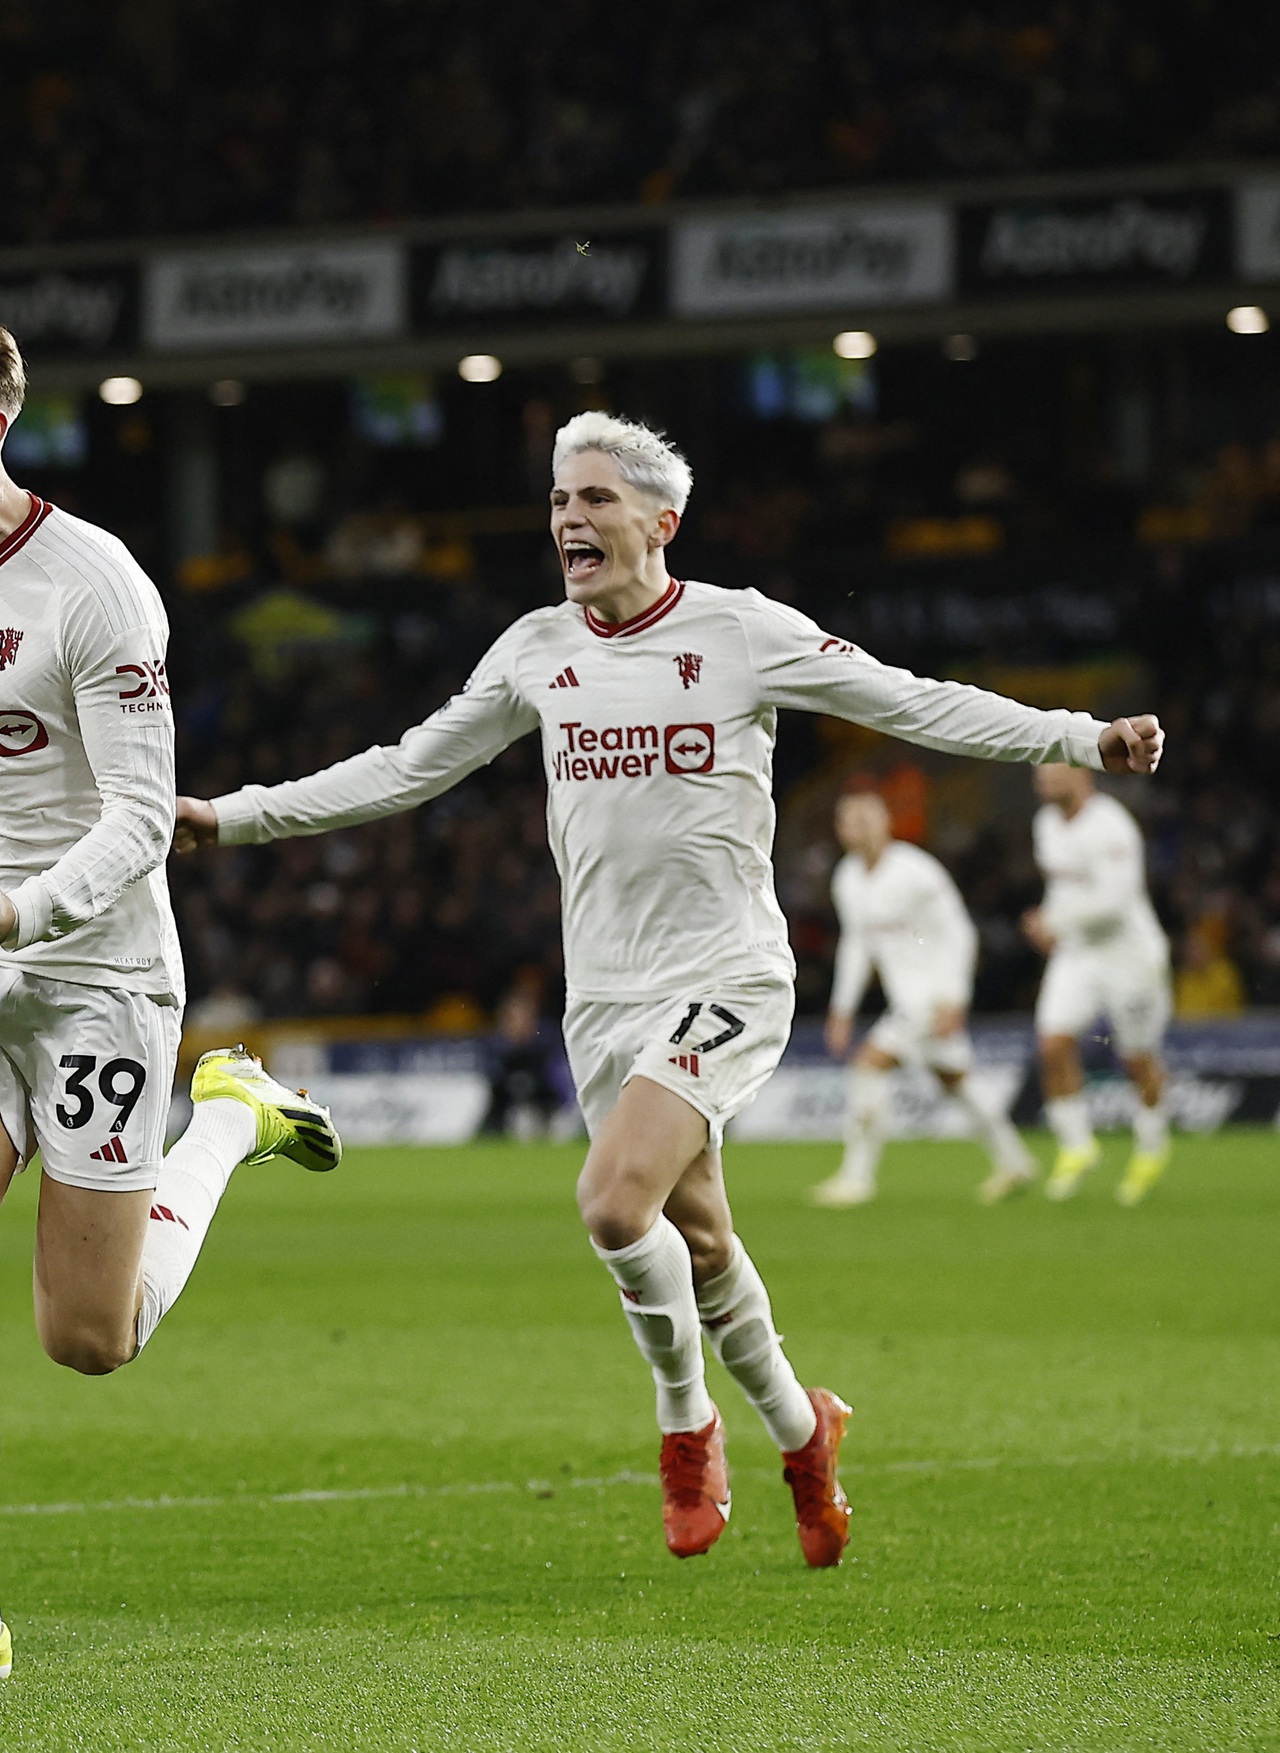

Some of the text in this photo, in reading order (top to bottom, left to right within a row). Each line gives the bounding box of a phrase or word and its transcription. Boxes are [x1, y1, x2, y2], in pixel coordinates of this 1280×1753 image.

[560, 722, 659, 753] Team
[552, 750, 660, 781] Viewer
[669, 1002, 746, 1053] 17
[56, 1054, 147, 1133] 39
